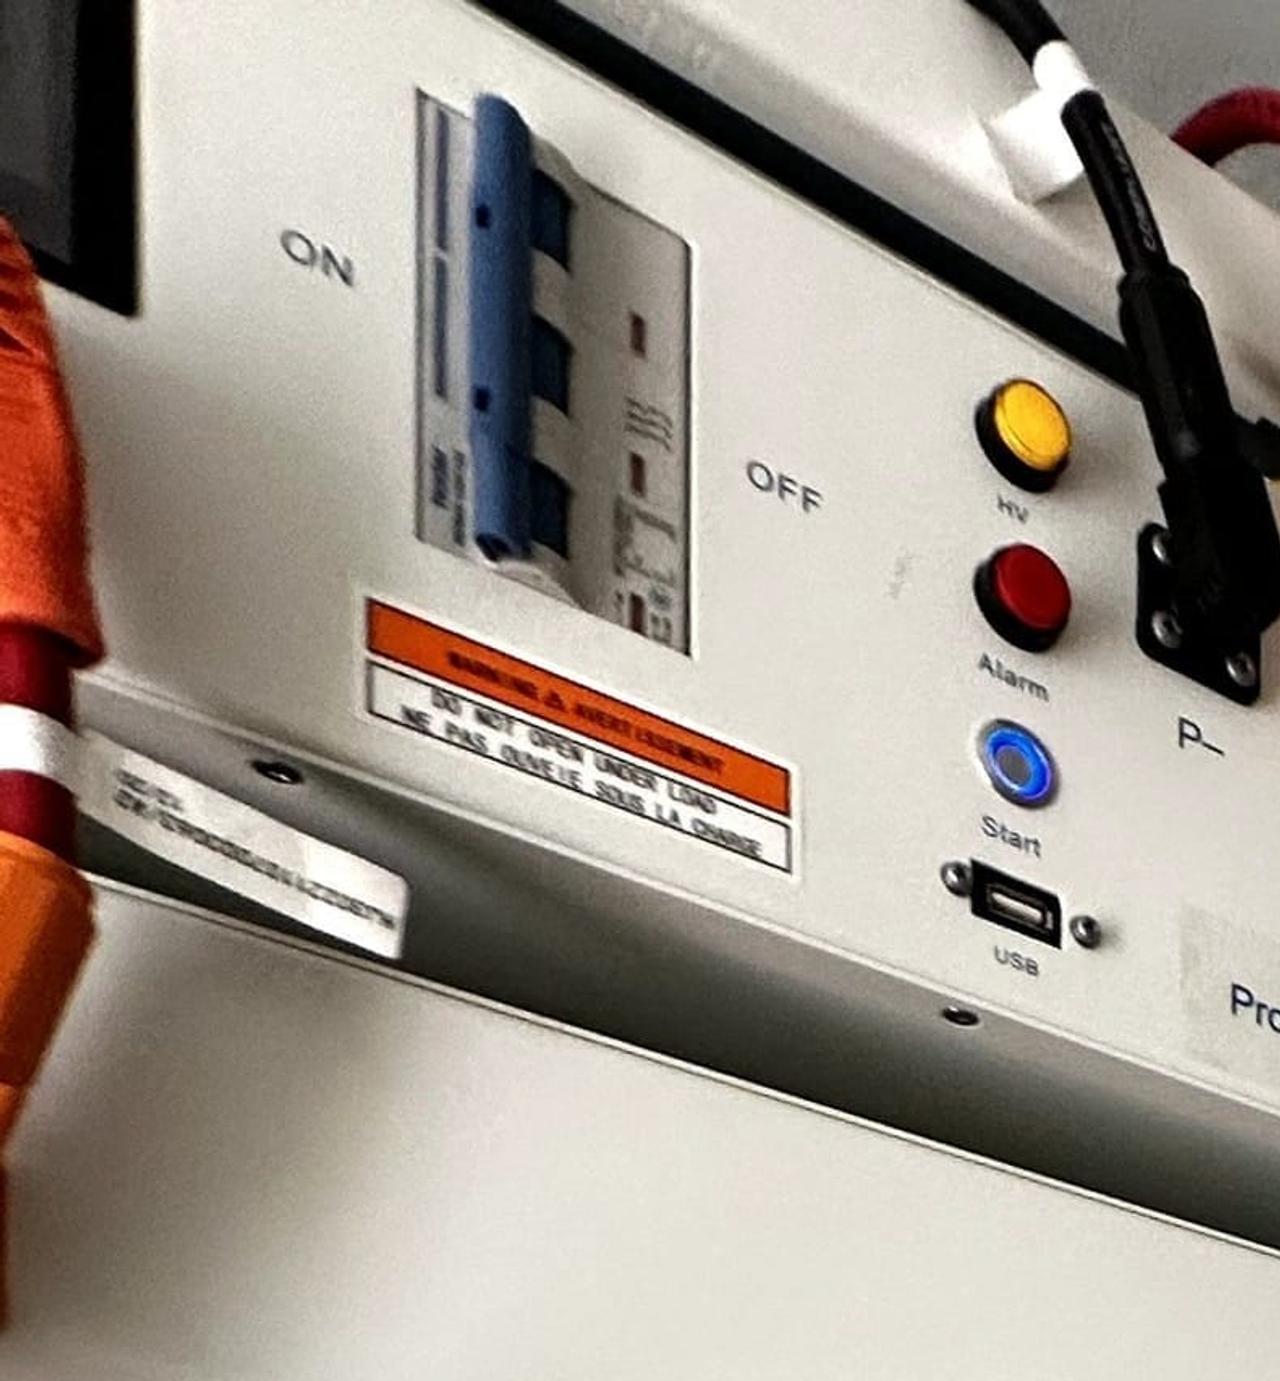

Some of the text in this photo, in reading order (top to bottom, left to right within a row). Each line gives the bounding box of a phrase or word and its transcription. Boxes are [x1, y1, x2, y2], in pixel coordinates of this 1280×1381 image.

[280, 229, 353, 287] ON
[747, 460, 823, 514] OFF
[998, 496, 1029, 524] HV
[979, 652, 1049, 701] Alarm
[431, 687, 461, 715] DO
[475, 707, 515, 736] NOT
[529, 724, 584, 763] OPEN
[595, 750, 658, 792] UNDER
[401, 705, 431, 732] NE
[445, 720, 487, 755] PAS
[594, 780, 645, 813] SOUS
[655, 804, 682, 832] LA
[981, 816, 1042, 859] Start
[995, 945, 1040, 977] USB
